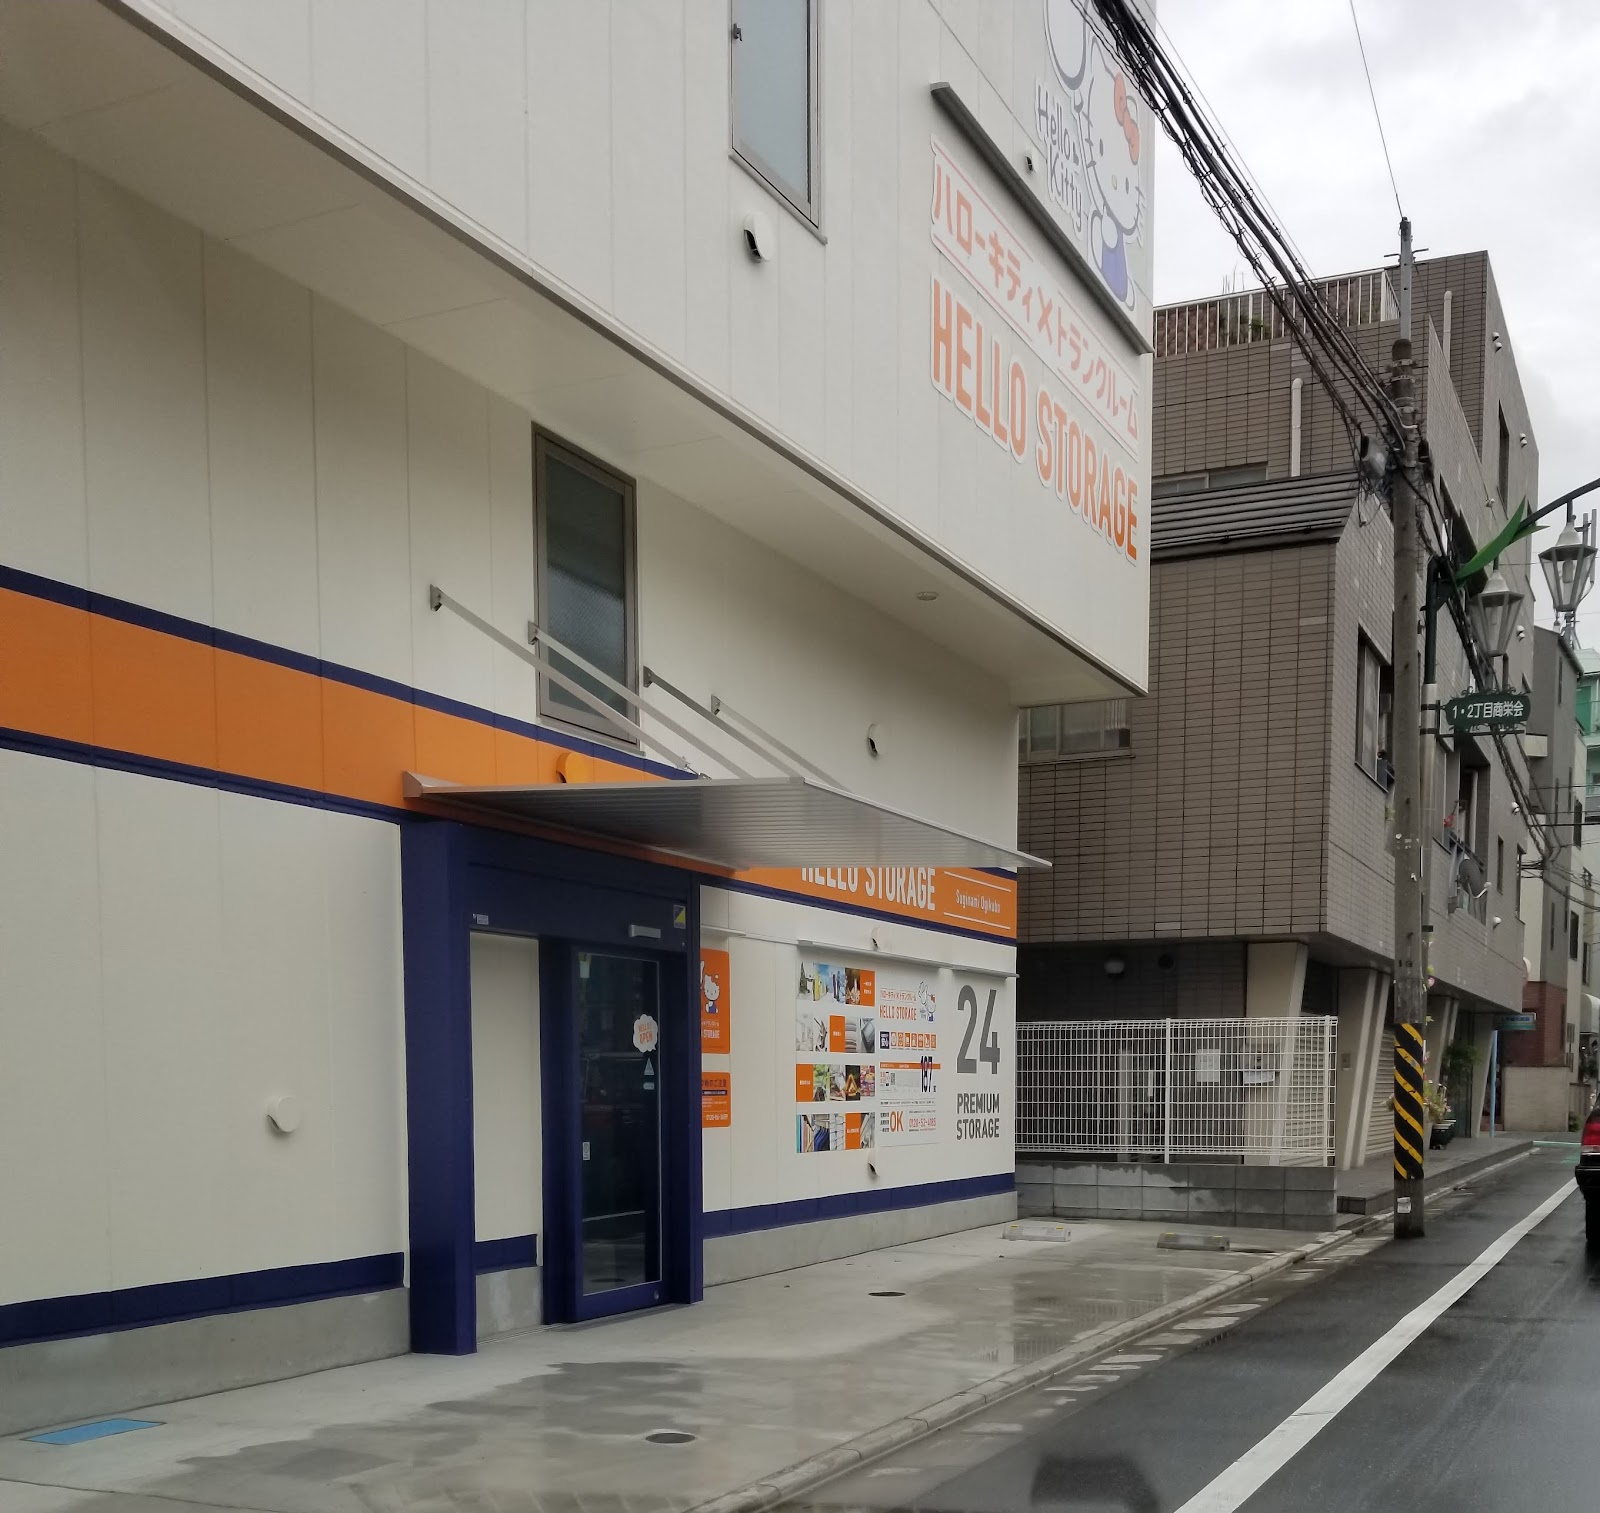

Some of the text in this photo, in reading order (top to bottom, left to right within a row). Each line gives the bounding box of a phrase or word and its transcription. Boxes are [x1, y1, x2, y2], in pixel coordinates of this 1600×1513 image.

[1037, 84, 1071, 161] Hello
[1049, 143, 1082, 233] Kitty
[933, 276, 1138, 562] HELLO STORAGE
[879, 1005, 894, 1019] HELLO
[896, 1006, 917, 1021] STORAGE
[957, 985, 1000, 1074] 24
[890, 1111, 904, 1133] OK
[957, 1092, 1000, 1114] PREMIUM
[956, 1117, 1000, 1140] STORAGE
